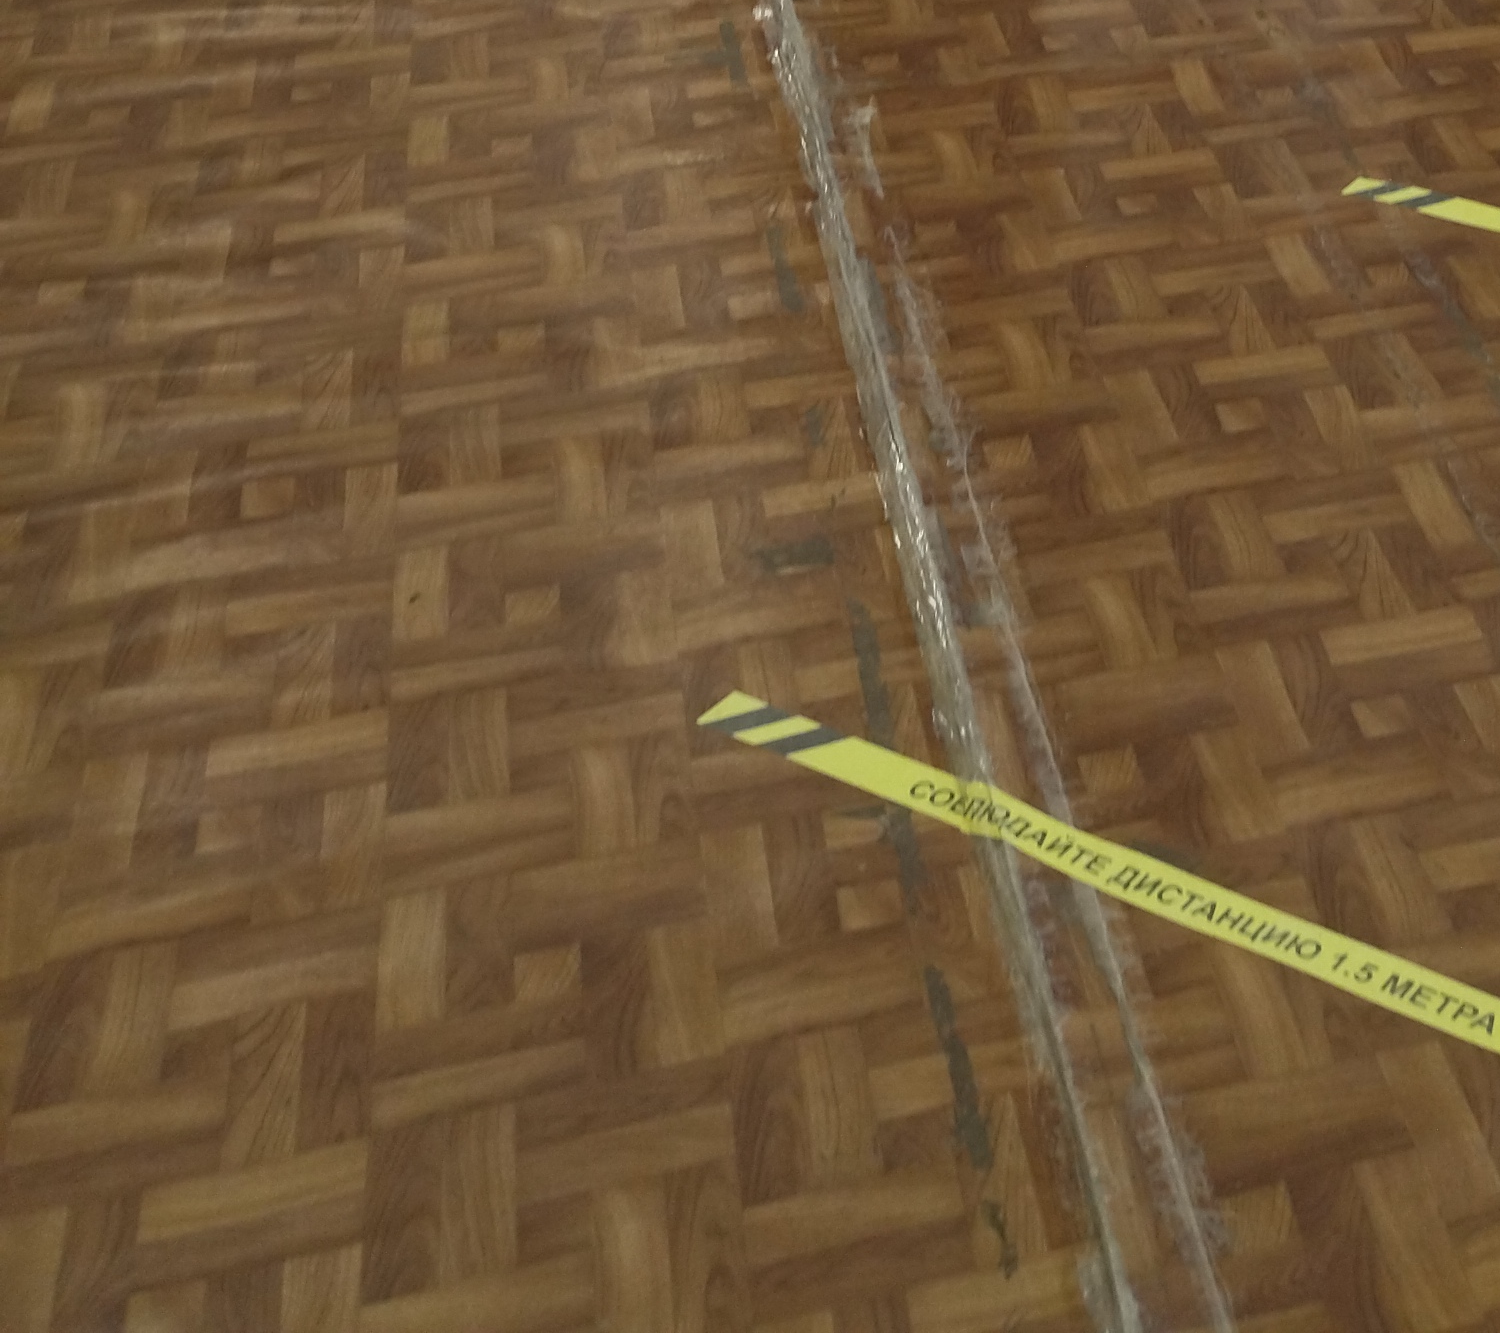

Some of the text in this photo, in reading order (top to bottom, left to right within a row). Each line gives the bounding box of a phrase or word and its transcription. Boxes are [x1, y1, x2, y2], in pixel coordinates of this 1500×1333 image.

[908, 778, 1497, 1036] СОБЛЮДАЙТЕ ДИСТАНЦИЮ 1.5 МЕТРА
